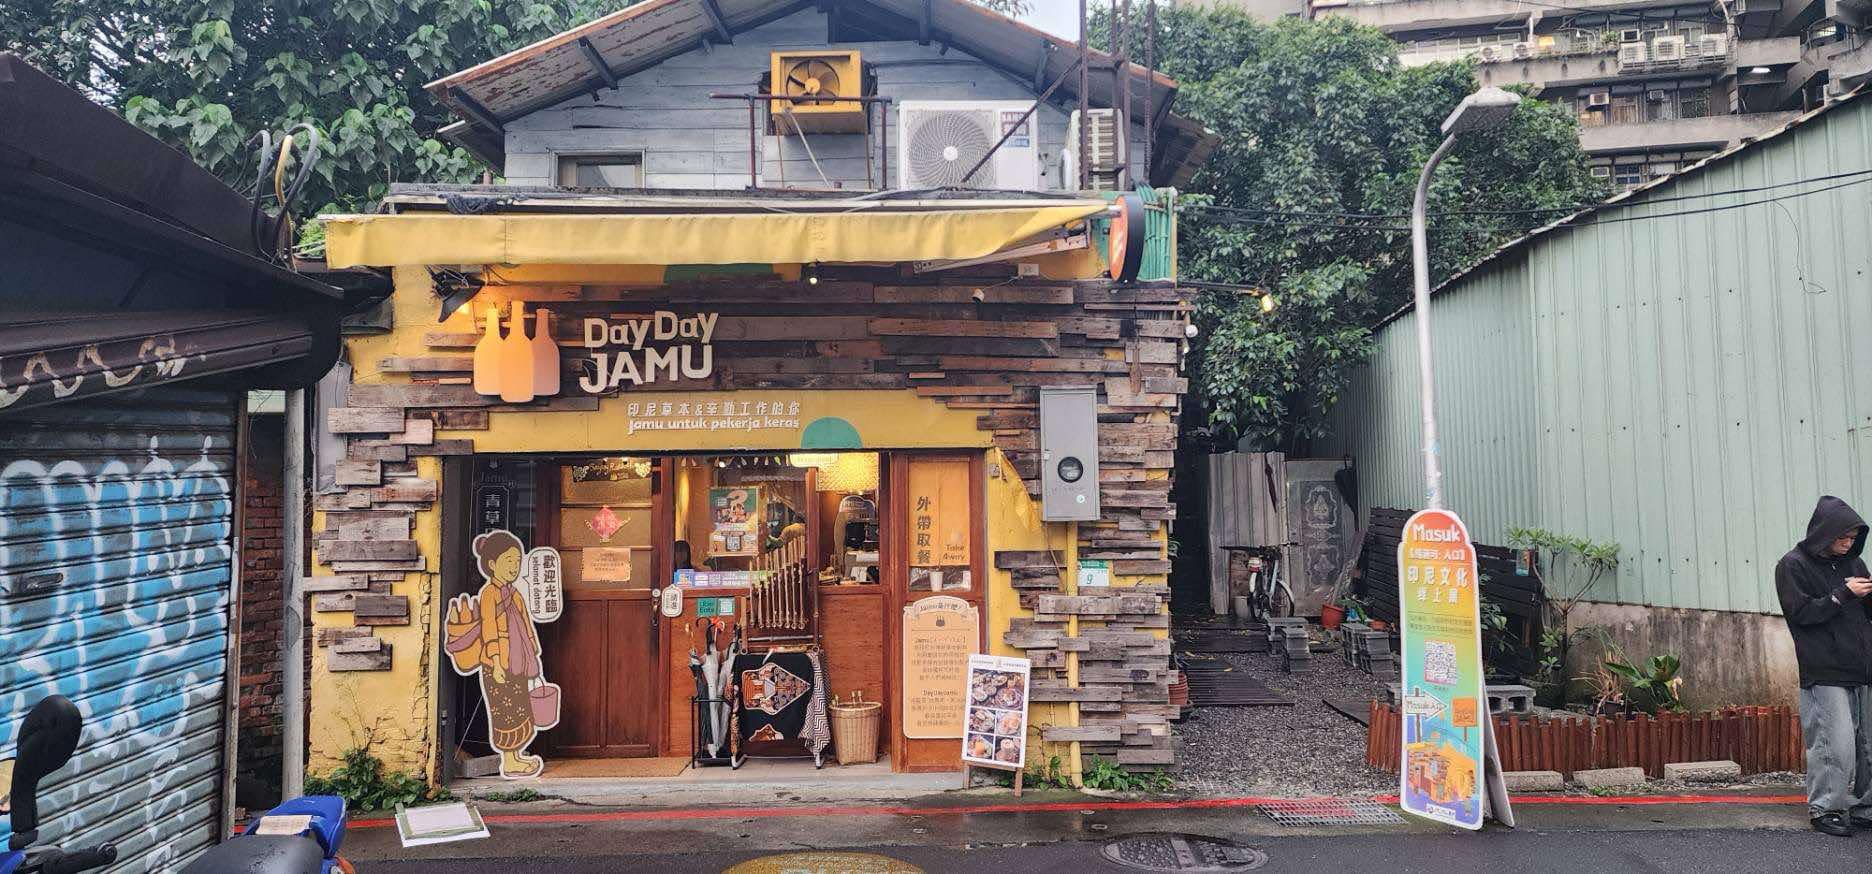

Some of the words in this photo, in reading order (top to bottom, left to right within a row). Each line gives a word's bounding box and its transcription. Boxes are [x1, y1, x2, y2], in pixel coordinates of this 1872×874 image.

[579, 344, 713, 394] JAMU
[667, 416, 707, 429] untuk
[710, 416, 760, 432] pekerja
[763, 415, 800, 429] keras
[916, 495, 931, 564] 外帶取餐
[1412, 523, 1461, 543] Masuk
[532, 556, 541, 586] selamat
[542, 554, 558, 613] 歡迎光臨
[1407, 565, 1470, 589] 印尼文化
[532, 587, 542, 615] datang
